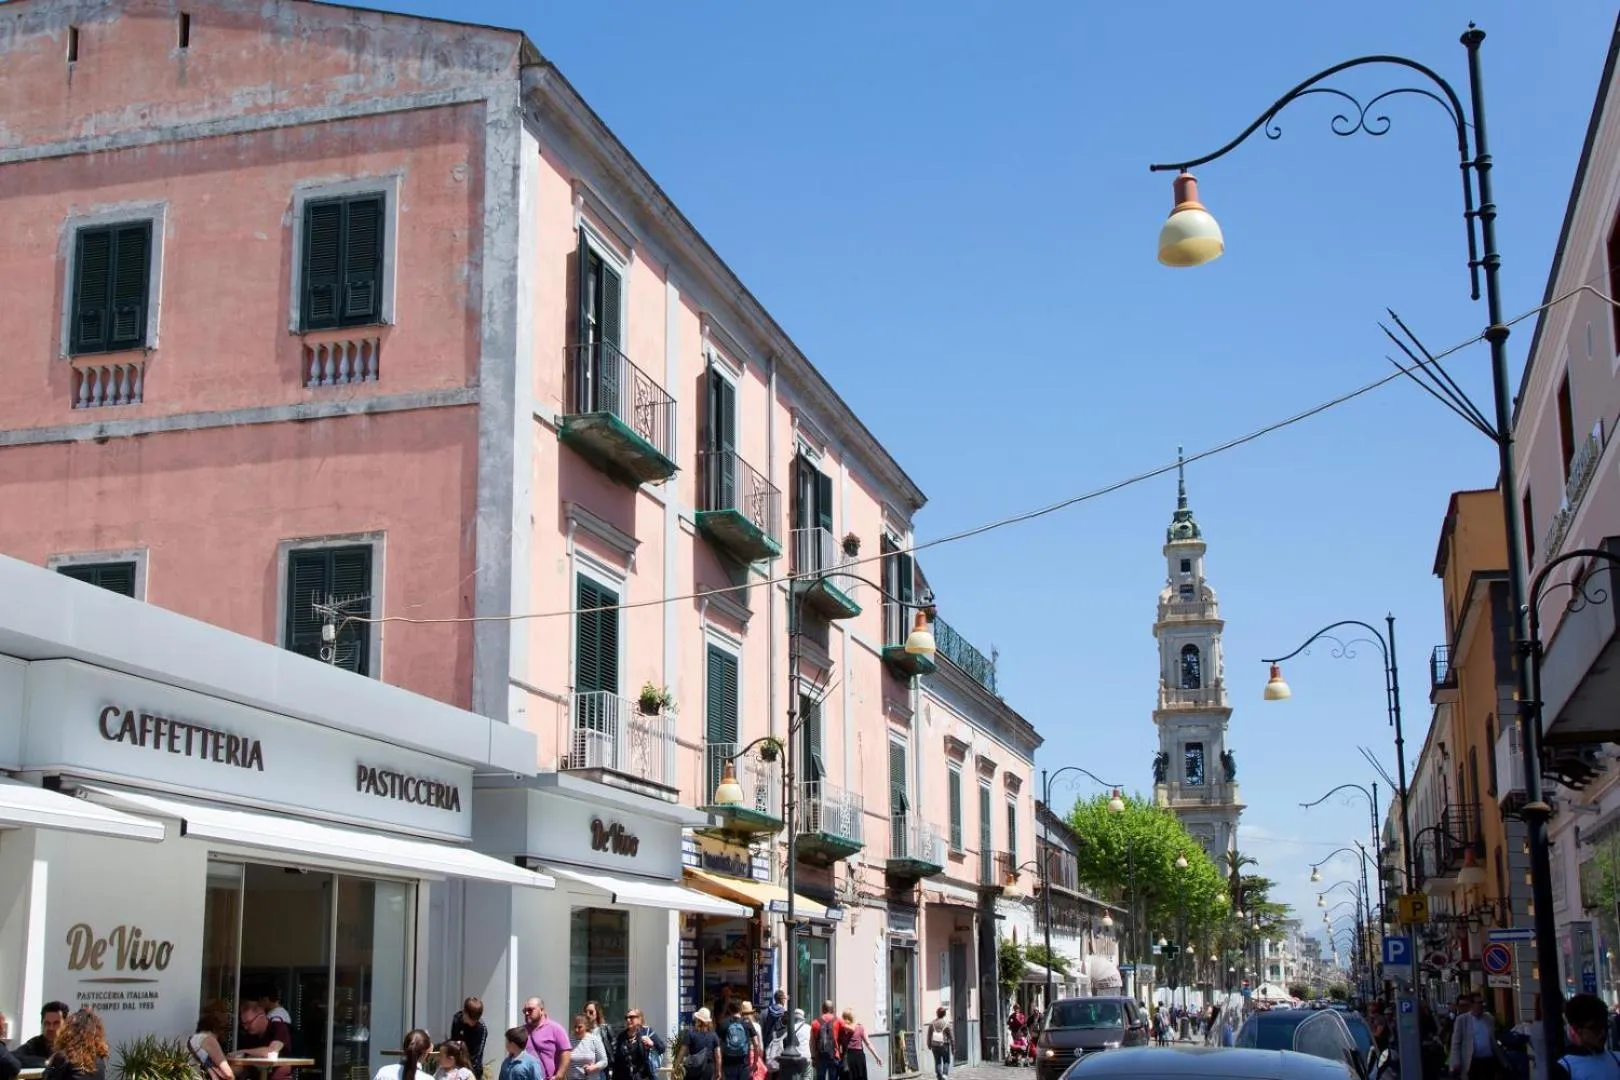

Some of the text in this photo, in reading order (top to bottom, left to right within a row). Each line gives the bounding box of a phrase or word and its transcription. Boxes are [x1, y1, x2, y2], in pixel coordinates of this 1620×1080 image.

[99, 706, 264, 771] CAFFETTERIA
[356, 764, 461, 812] PASTICCERIA
[591, 819, 639, 857] De Vivo
[1412, 902, 1423, 917] P
[66, 923, 174, 971] De Vivo
[1388, 940, 1405, 962] P
[77, 991, 159, 1000] PASTICCERIA ITALIANA
[92, 1002, 120, 1010] POMPEI
[122, 1002, 136, 1010] DAL
[1402, 1002, 1411, 1012] P
